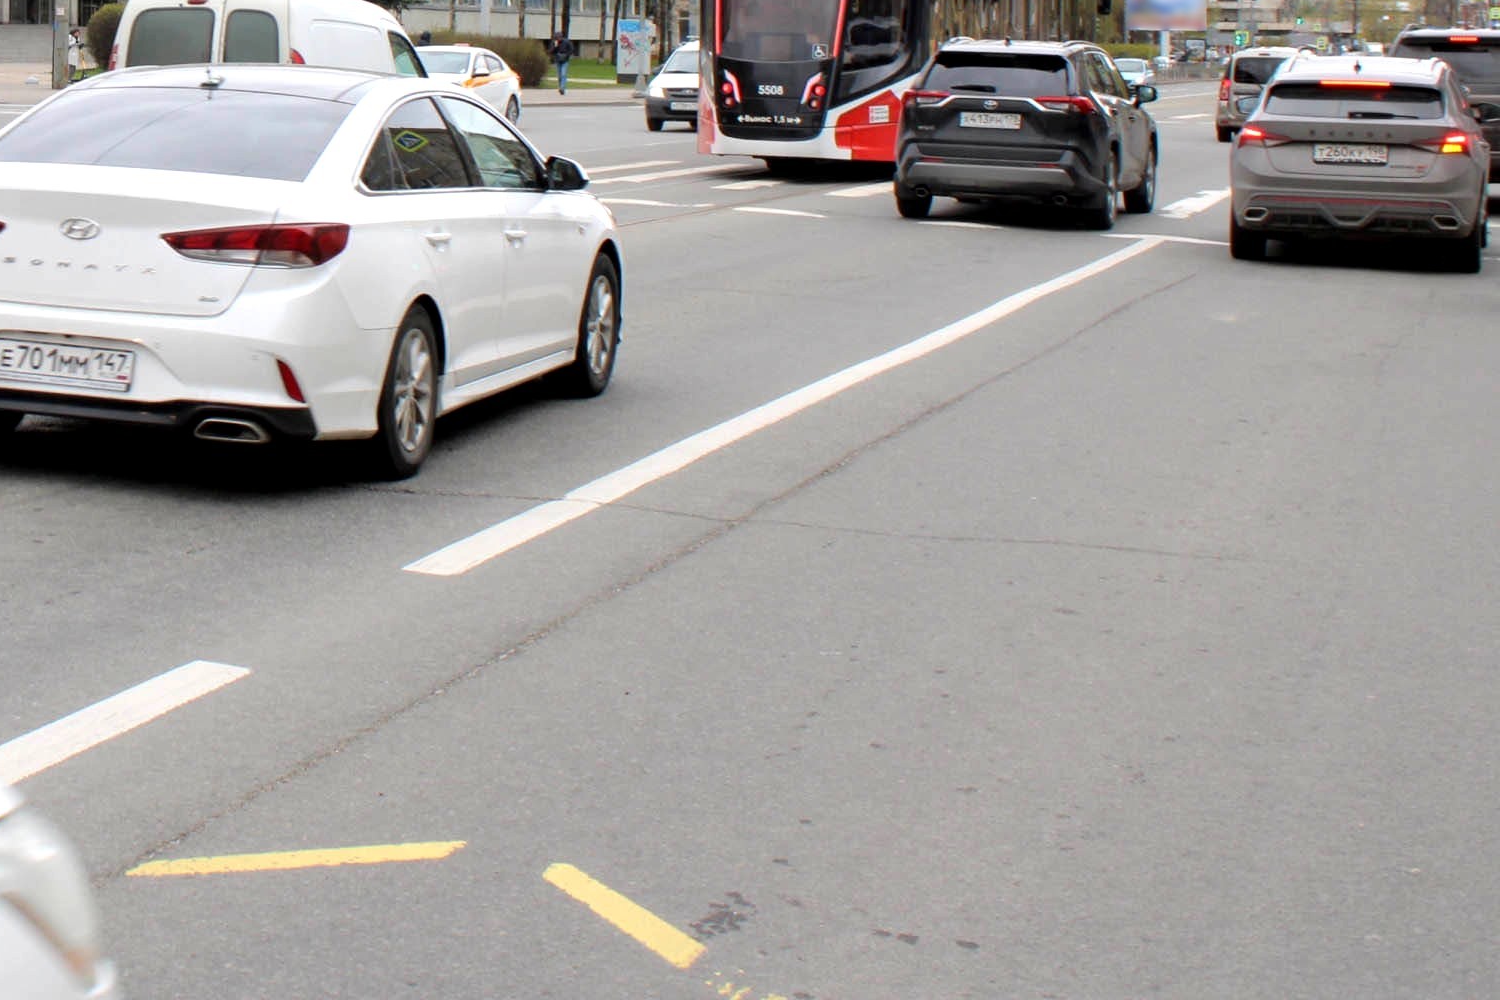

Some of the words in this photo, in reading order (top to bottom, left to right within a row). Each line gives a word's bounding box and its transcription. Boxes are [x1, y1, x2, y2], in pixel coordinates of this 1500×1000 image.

[757, 84, 784, 96] 5508
[0, 345, 90, 375] Е701ММ
[94, 353, 128, 373] 147
